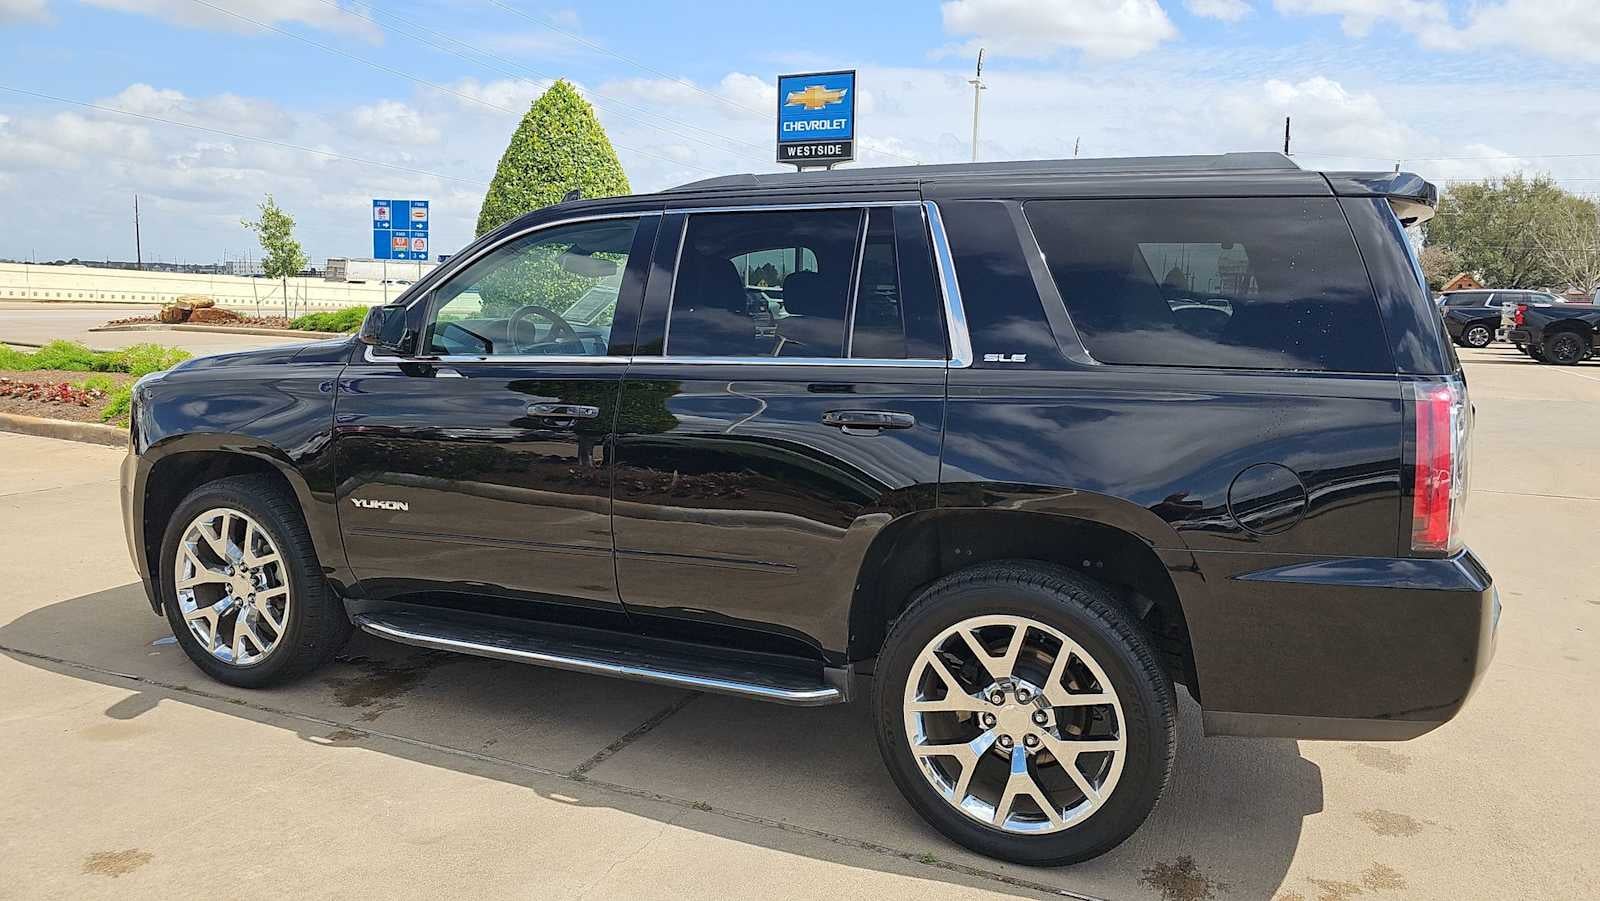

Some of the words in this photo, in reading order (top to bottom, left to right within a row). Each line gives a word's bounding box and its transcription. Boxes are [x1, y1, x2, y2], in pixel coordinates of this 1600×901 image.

[783, 118, 847, 132] CHEVROLET
[787, 144, 842, 156] WESTSIDE
[983, 353, 1027, 362] SLE
[351, 498, 409, 511] YUKON
